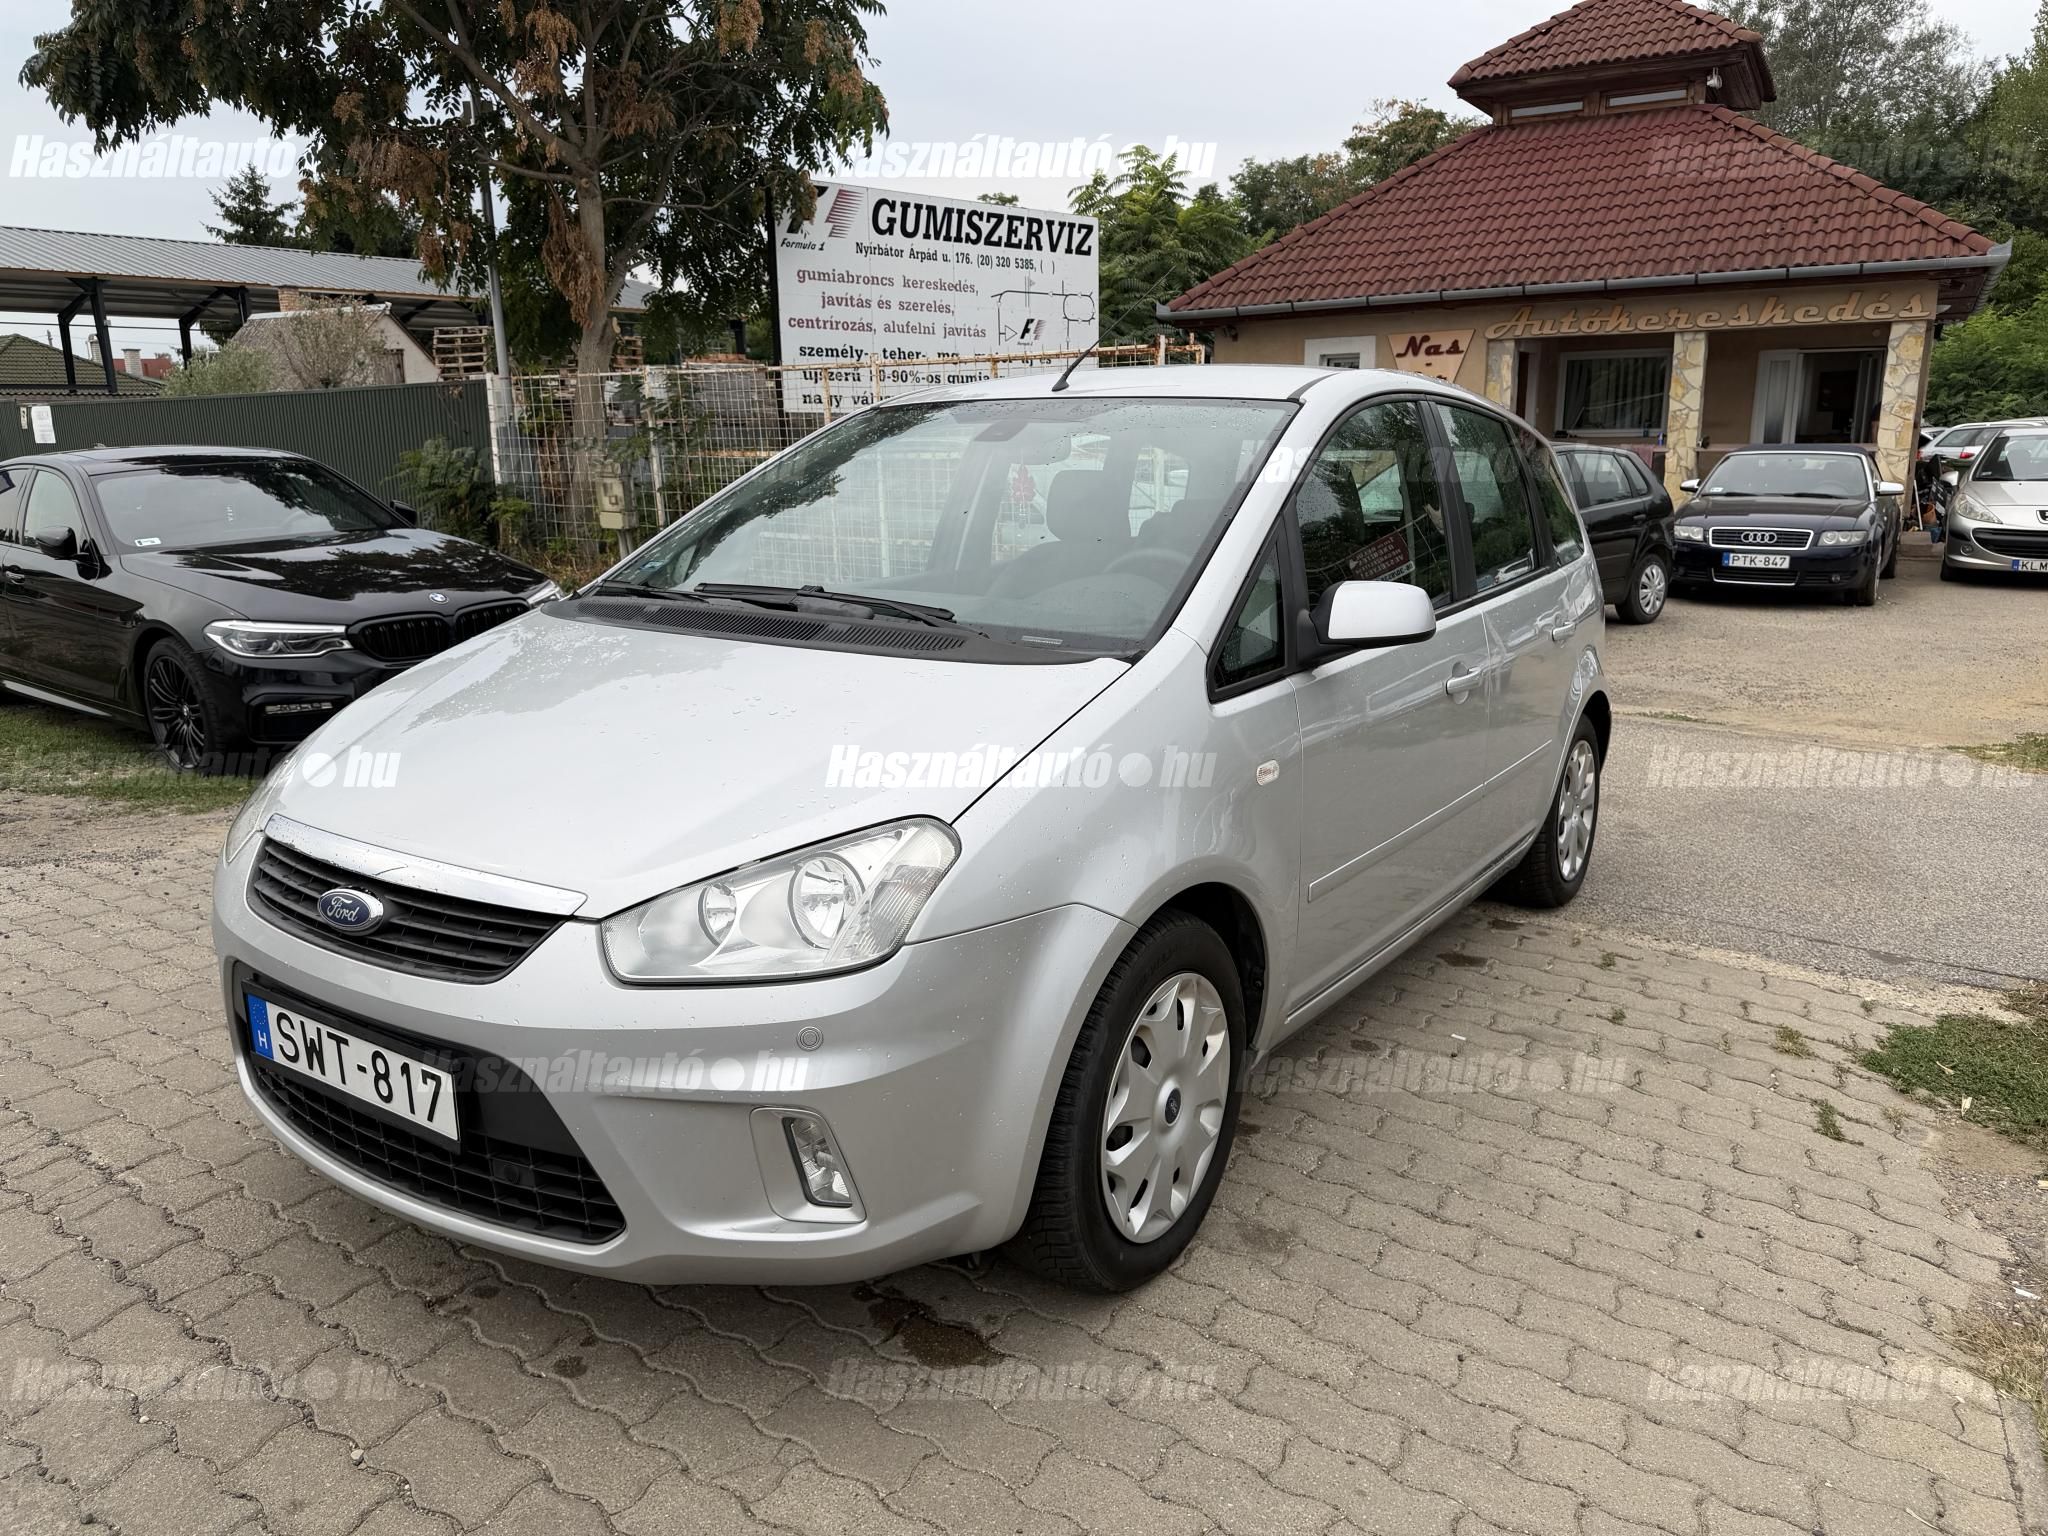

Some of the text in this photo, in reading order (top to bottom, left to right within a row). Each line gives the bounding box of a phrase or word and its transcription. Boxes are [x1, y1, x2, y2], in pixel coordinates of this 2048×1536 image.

[872, 198, 1094, 256] GUMISZERVIZ
[780, 238, 816, 250] Formula
[856, 242, 904, 258] Nyírbátor
[909, 243, 937, 263] Árpád
[942, 253, 951, 263] u.
[956, 252, 973, 264] 176.
[977, 253, 993, 269] (20)
[995, 256, 1010, 268] 320
[1014, 258, 1037, 272] 5385,
[797, 269, 979, 297] gumiabroncs kereskedés,
[821, 291, 955, 316] javítás és szerelés,
[1484, 292, 1931, 340] Autókereskedés
[788, 315, 986, 339] centrírozás, alufelni javítás
[1396, 335, 1464, 358] Nas
[1732, 555, 1787, 567] PTK-847
[326, 896, 360, 923] Ford
[276, 1011, 442, 1123] SWT-817
